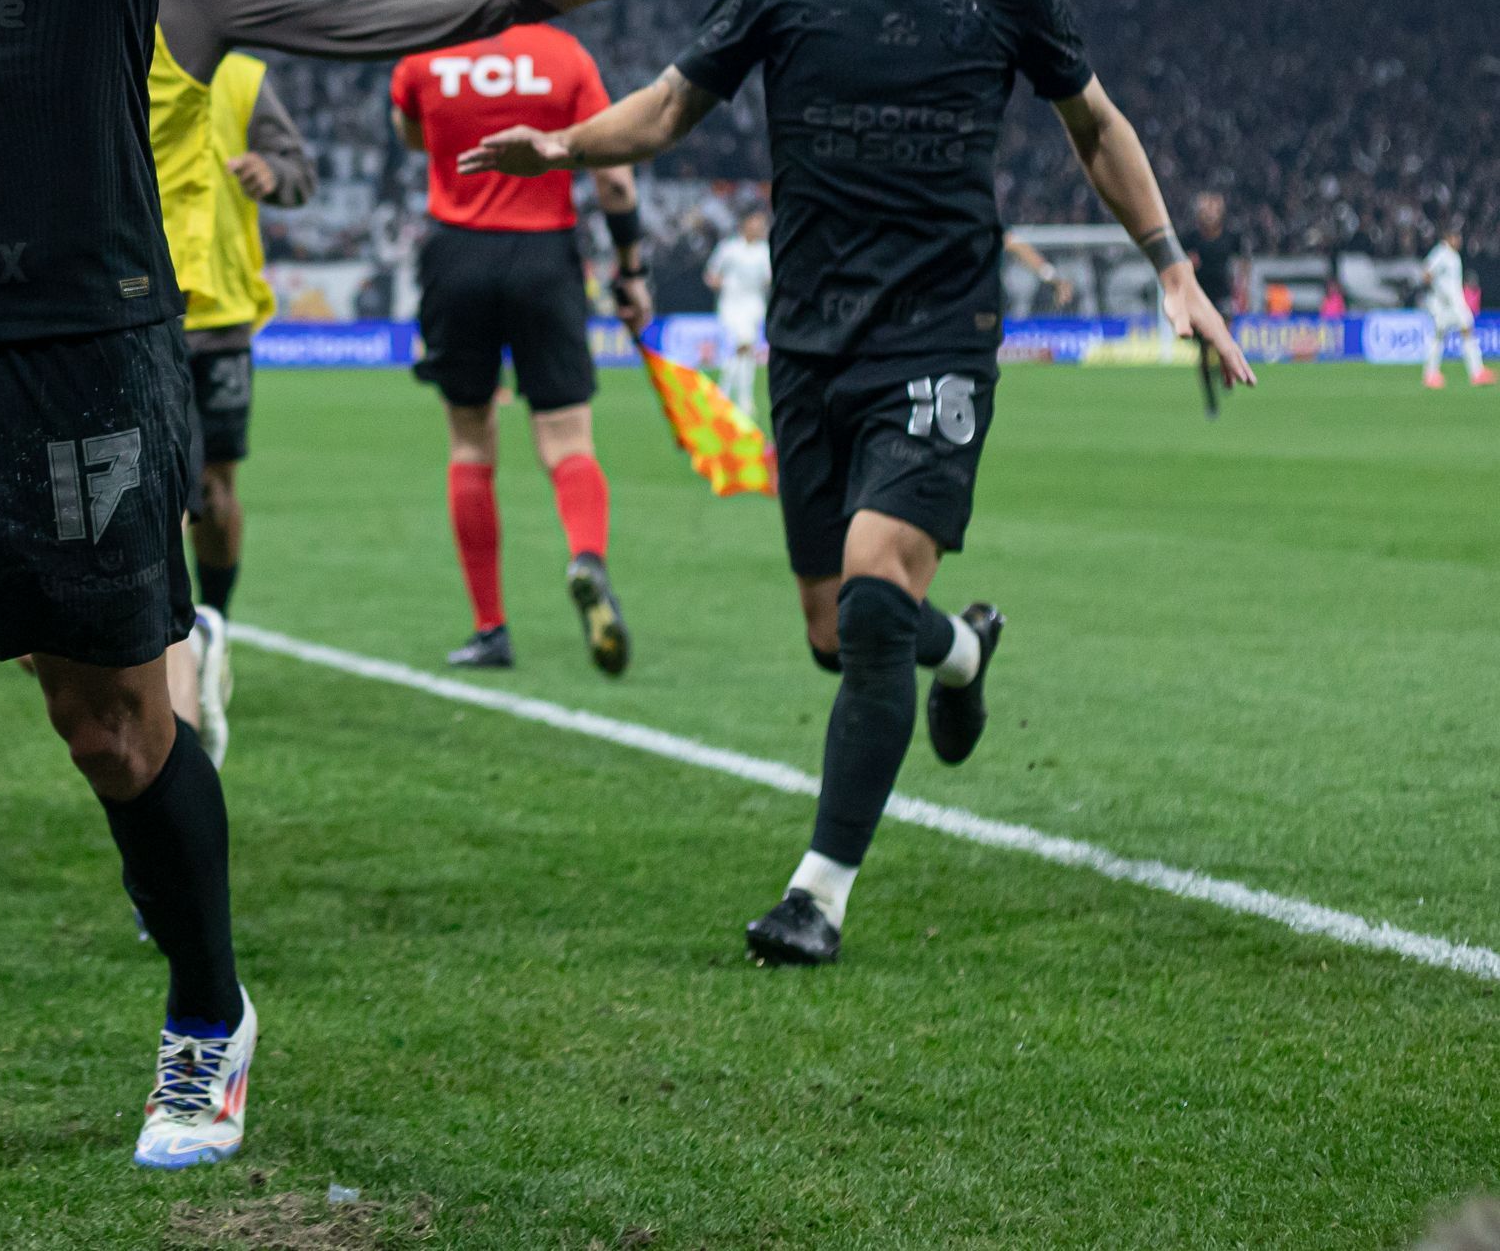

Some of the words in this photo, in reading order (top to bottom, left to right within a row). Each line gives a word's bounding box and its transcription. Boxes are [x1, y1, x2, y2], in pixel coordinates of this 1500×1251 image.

[429, 54, 552, 98] TCL
[803, 98, 975, 134] Esportes
[907, 374, 976, 445] 16
[47, 427, 142, 545] 17
